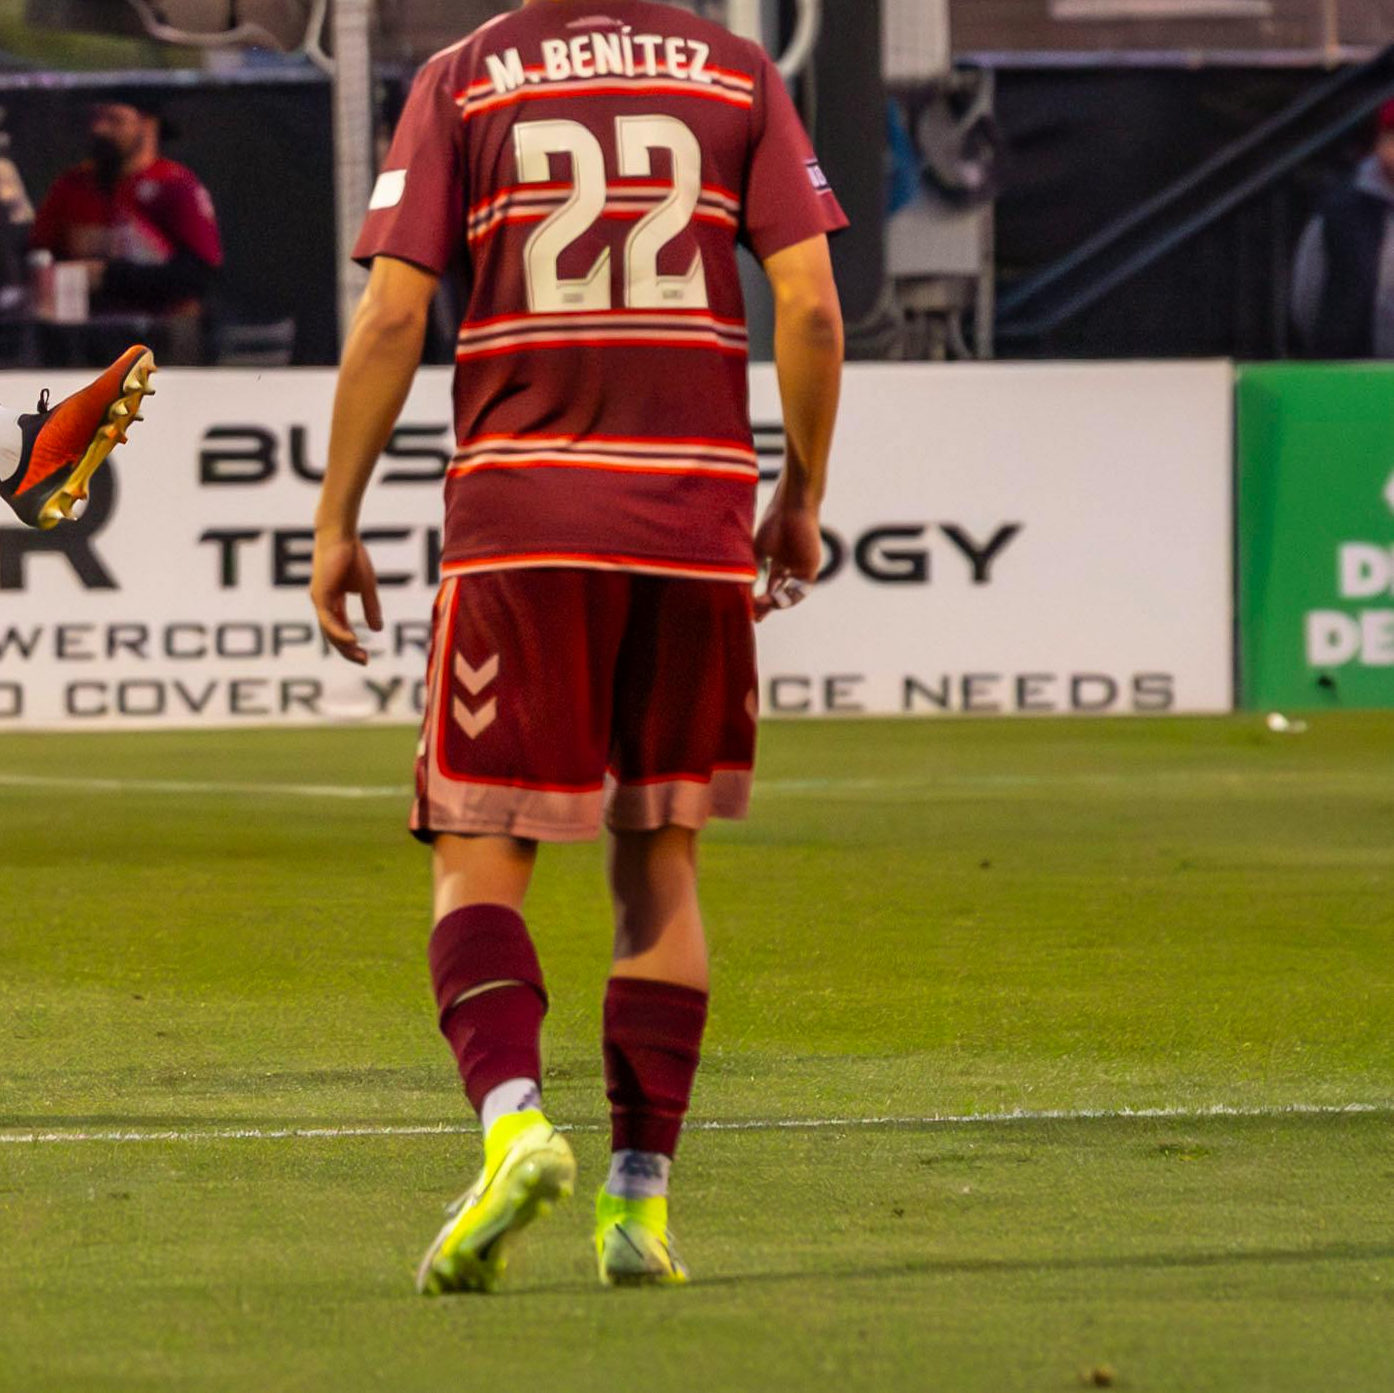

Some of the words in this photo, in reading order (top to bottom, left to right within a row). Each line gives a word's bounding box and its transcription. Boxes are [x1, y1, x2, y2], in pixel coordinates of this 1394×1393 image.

[513, 114, 710, 313] 22
[66, 677, 323, 718] COVER
[903, 672, 1176, 713] NEEDS
